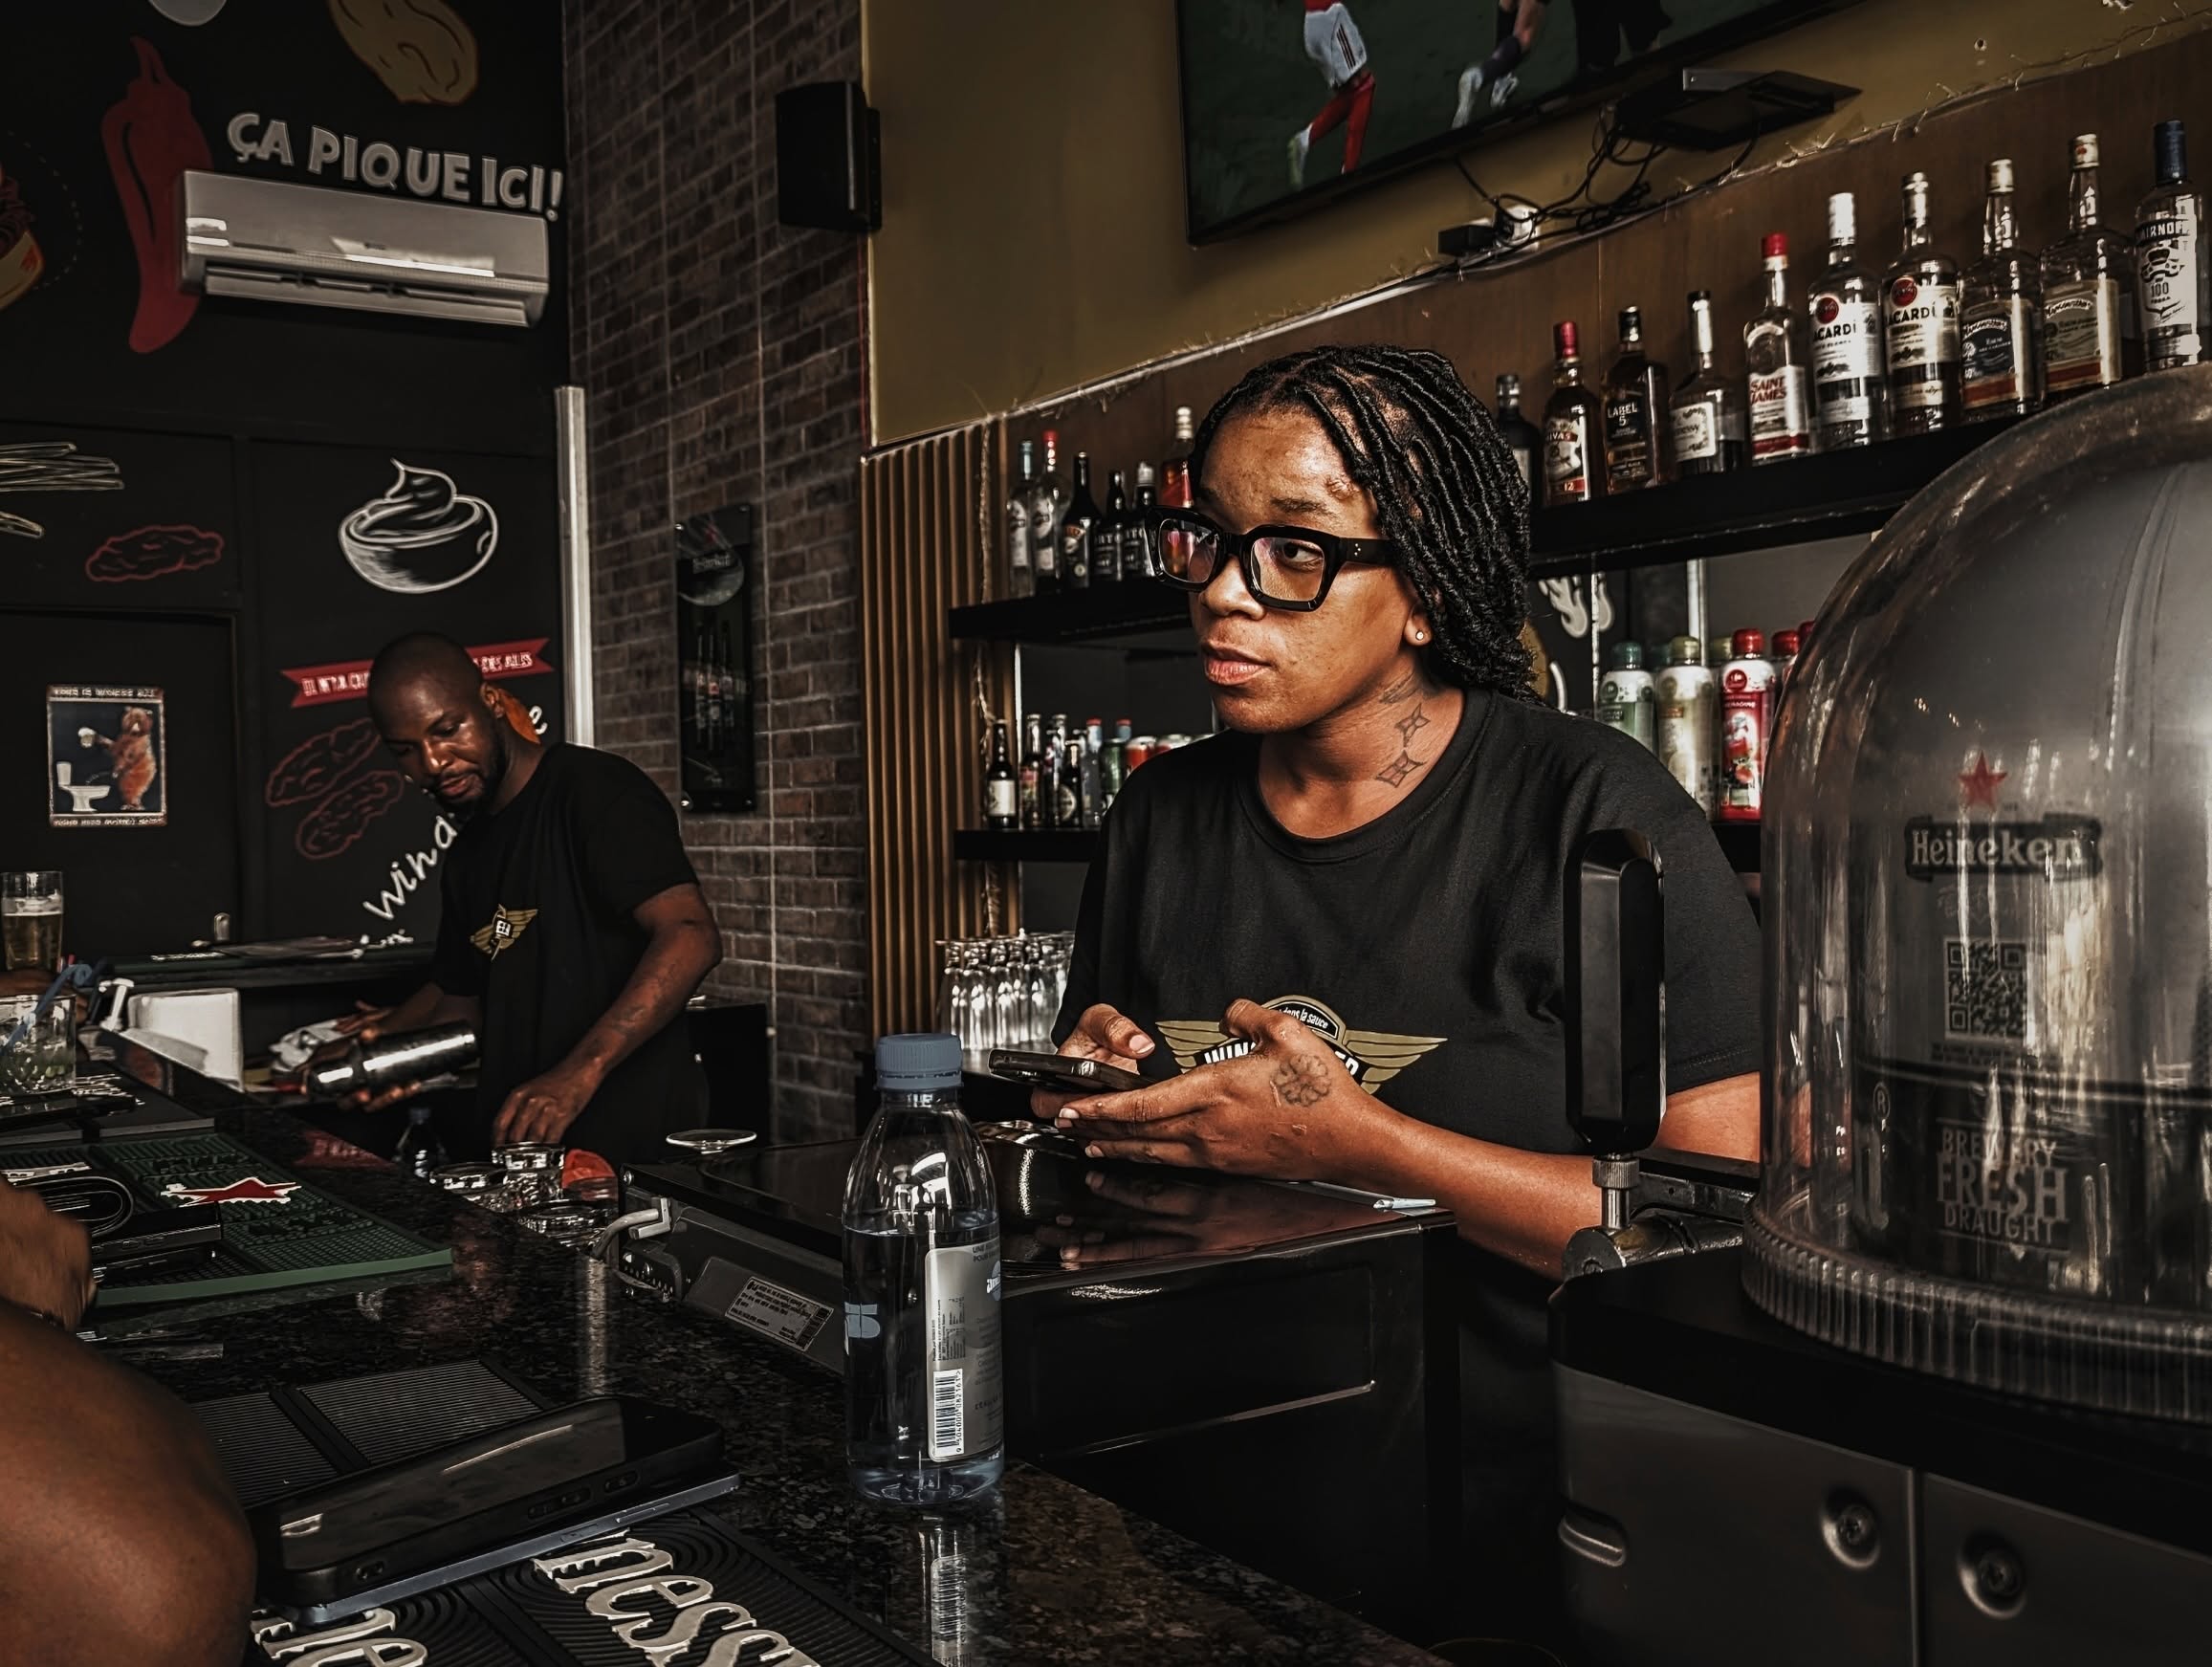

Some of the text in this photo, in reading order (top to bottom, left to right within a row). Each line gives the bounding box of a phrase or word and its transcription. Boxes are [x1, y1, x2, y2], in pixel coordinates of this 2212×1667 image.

[227, 112, 564, 222] ÇA PIQUE ICI!
[2151, 282, 2169, 297] 100
[1751, 377, 1785, 391] SAINT
[1751, 389, 1786, 405] JAMES
[1608, 402, 1637, 418] LABEL
[1618, 415, 1628, 428] 5
[1913, 828, 2088, 866] Heineken
[1306, 1013, 1328, 1029] sauce
[1937, 1152, 2069, 1222] FRESH
[1944, 1199, 2056, 1244] DRAUGHT
